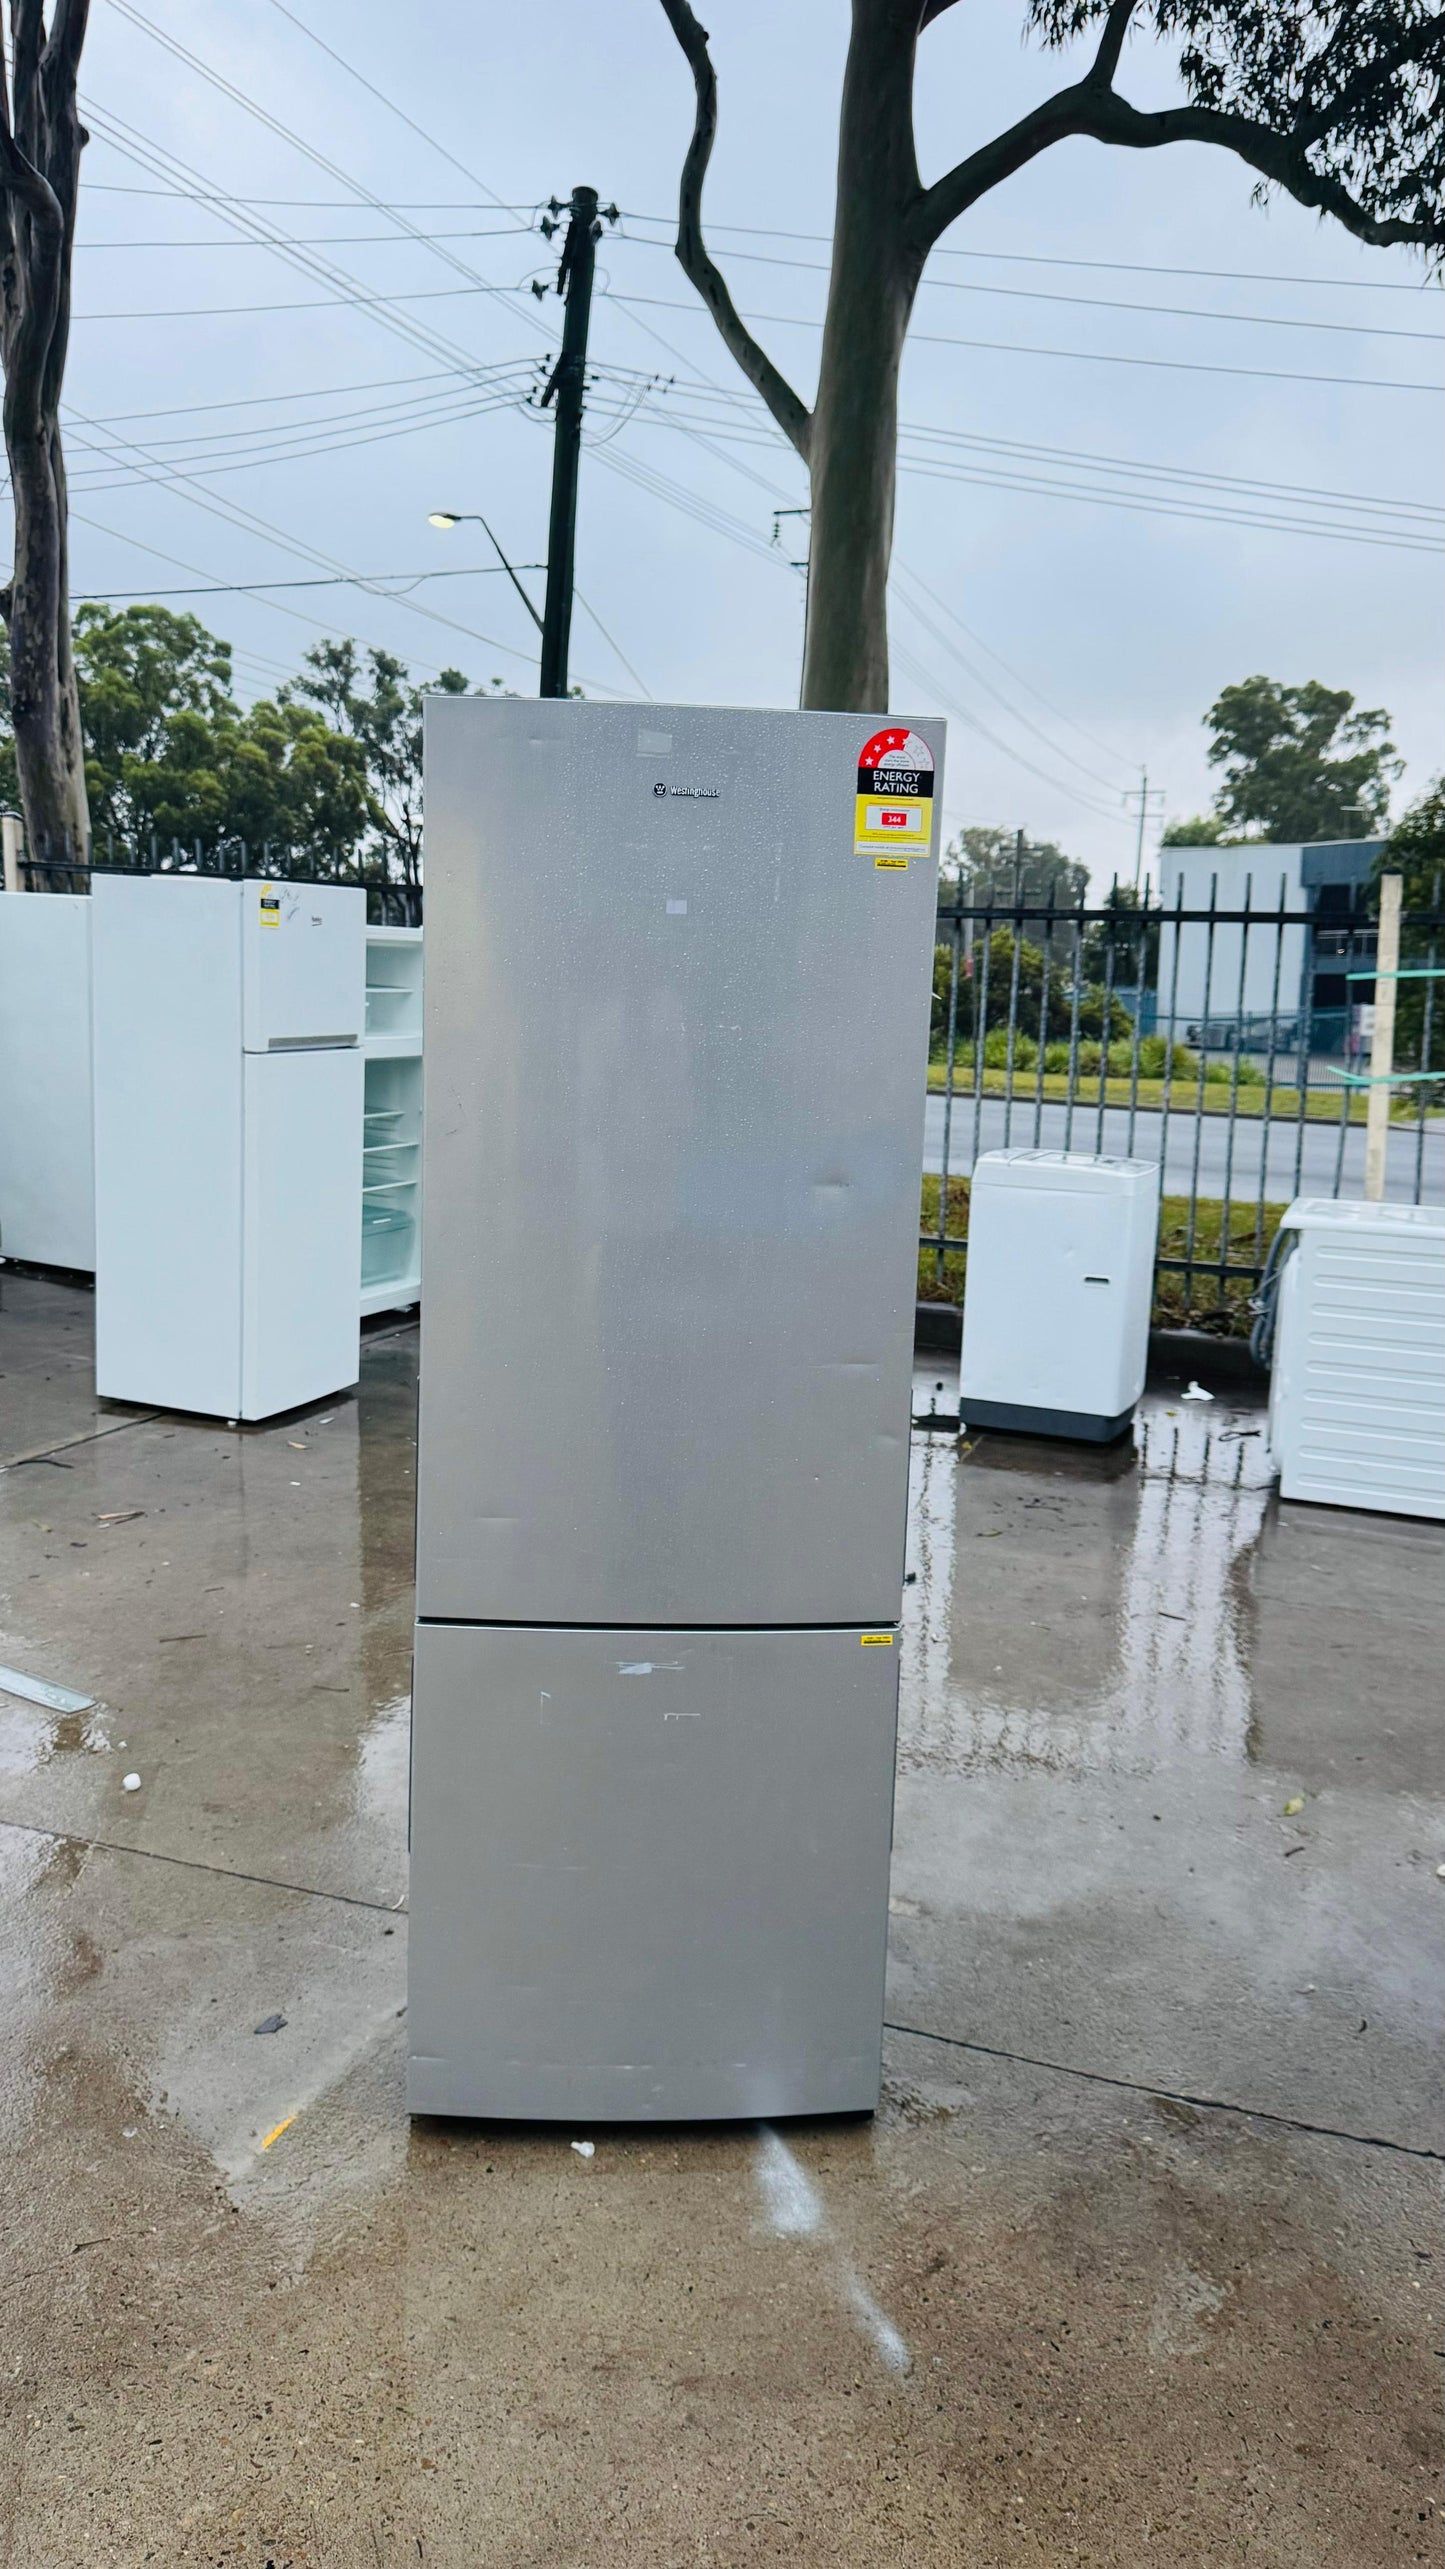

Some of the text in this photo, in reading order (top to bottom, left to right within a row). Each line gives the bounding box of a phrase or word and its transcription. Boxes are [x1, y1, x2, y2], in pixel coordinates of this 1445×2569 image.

[873, 770, 920, 783] ENERGY
[670, 785, 721, 798] Westinghouse
[873, 781, 919, 794] RATING
[887, 815, 902, 823] 344
